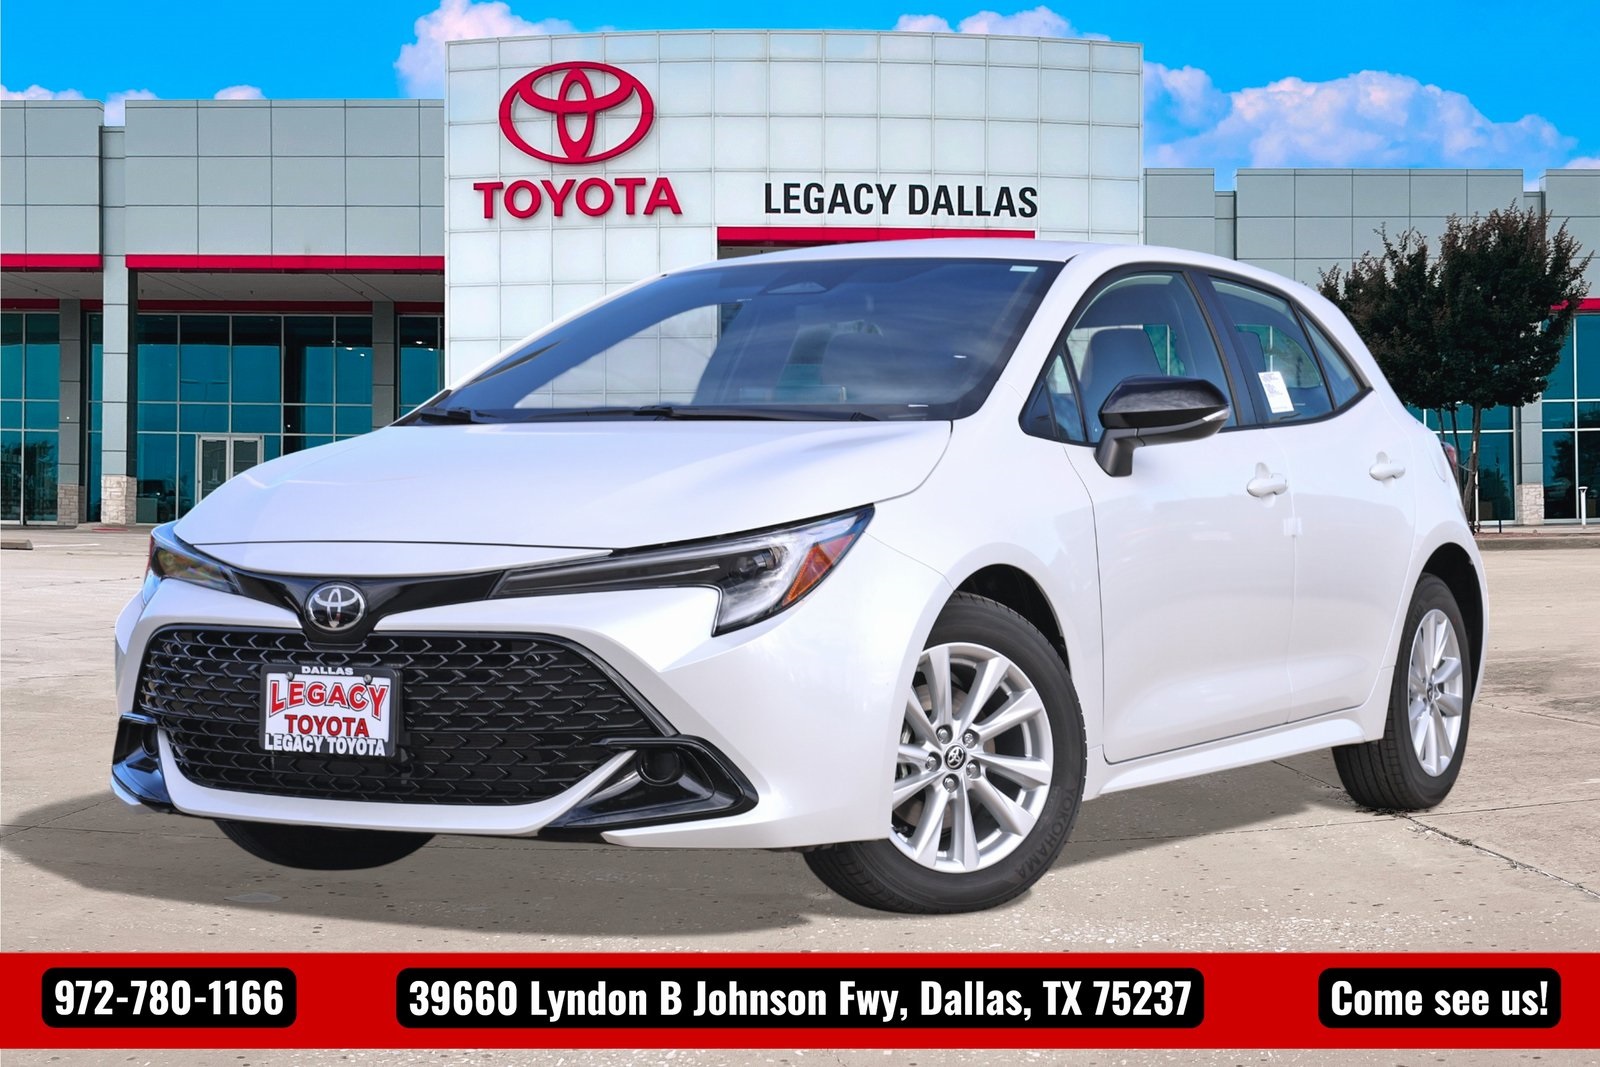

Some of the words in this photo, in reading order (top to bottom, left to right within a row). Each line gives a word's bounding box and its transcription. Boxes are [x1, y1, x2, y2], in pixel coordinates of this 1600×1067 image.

[474, 177, 681, 219] TOYOTA
[764, 182, 897, 215] LEGACY
[908, 184, 1038, 218] DALLAS
[301, 665, 354, 676] DALLAS
[269, 680, 389, 721] LEGACY
[284, 714, 370, 737] TOYOTA
[264, 733, 326, 753] LEGACY
[327, 736, 386, 757] TOYOTA
[1017, 787, 1078, 879] YOKOHAMA
